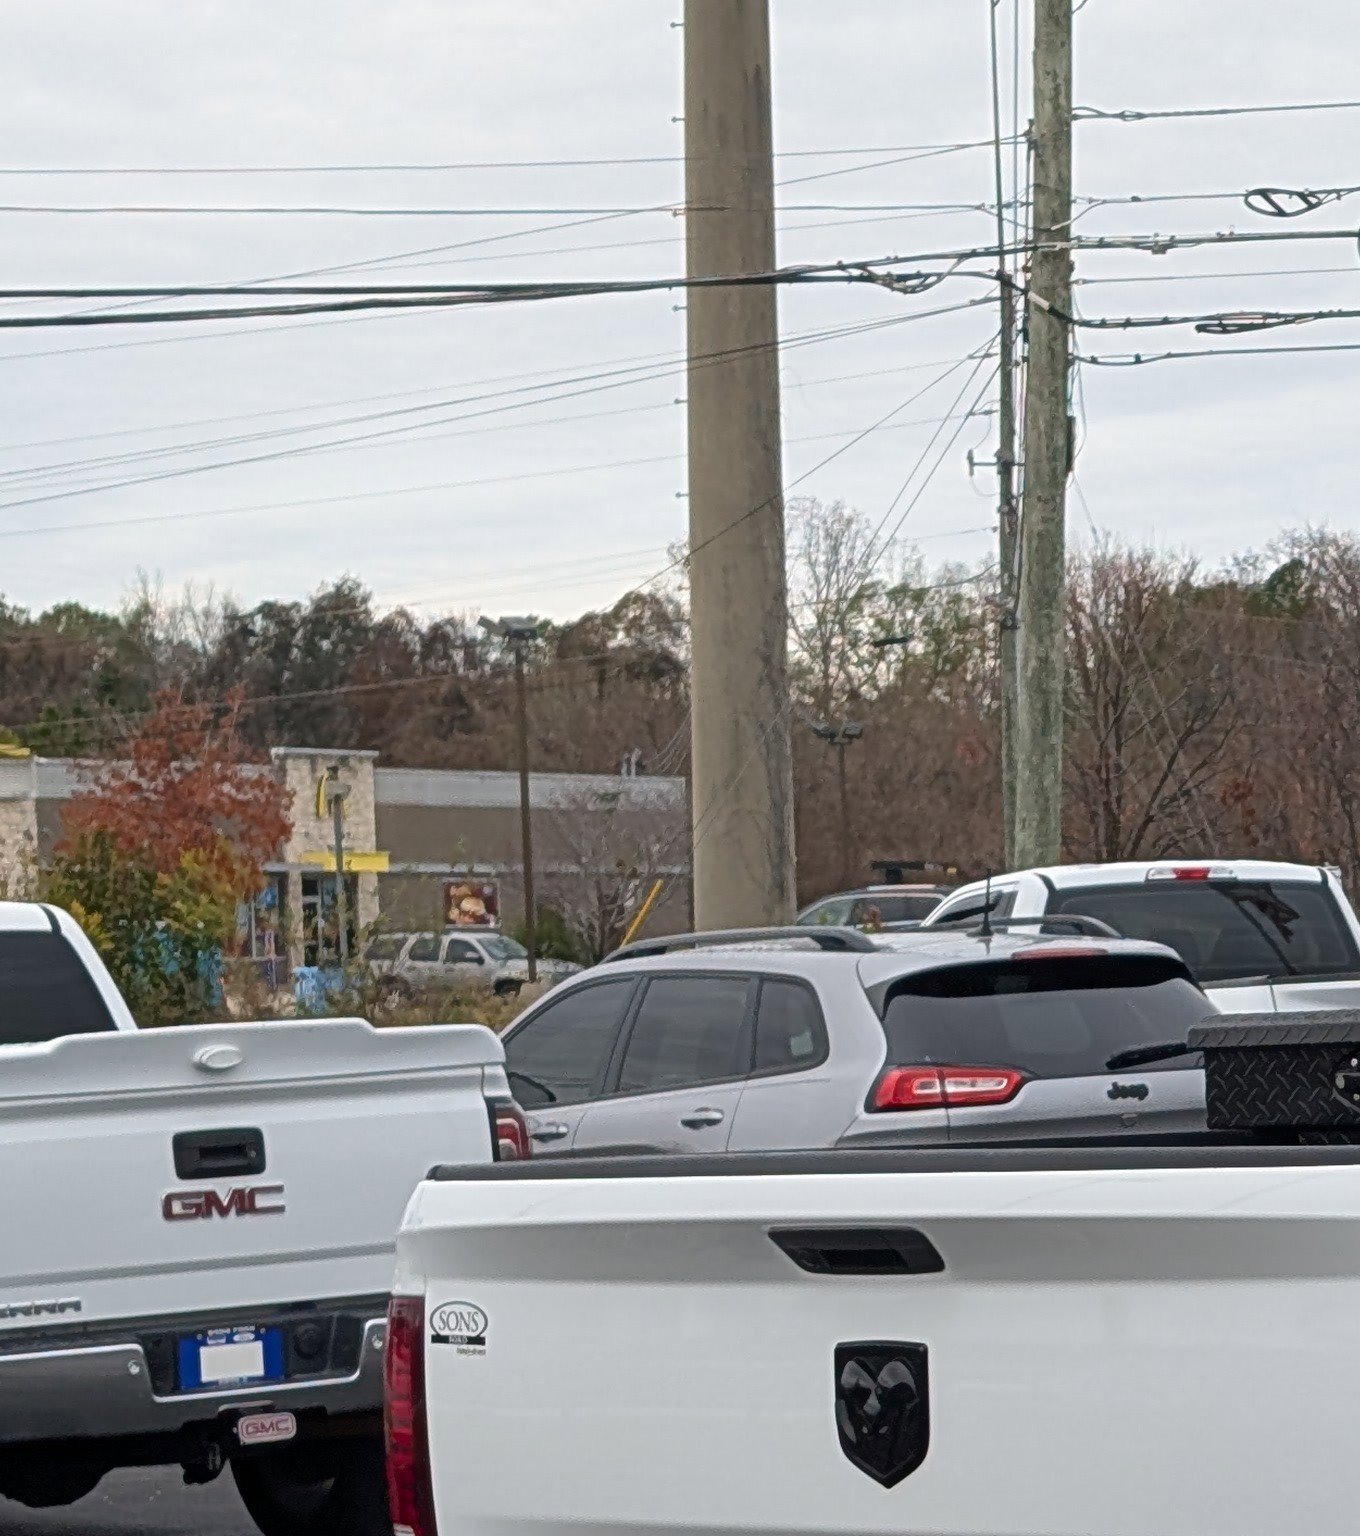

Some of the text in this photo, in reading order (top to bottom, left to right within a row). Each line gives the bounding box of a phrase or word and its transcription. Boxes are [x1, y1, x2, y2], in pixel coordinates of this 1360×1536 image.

[162, 1184, 286, 1221] GMC
[438, 1310, 479, 1333] SONS
[246, 1419, 291, 1435] GMC
